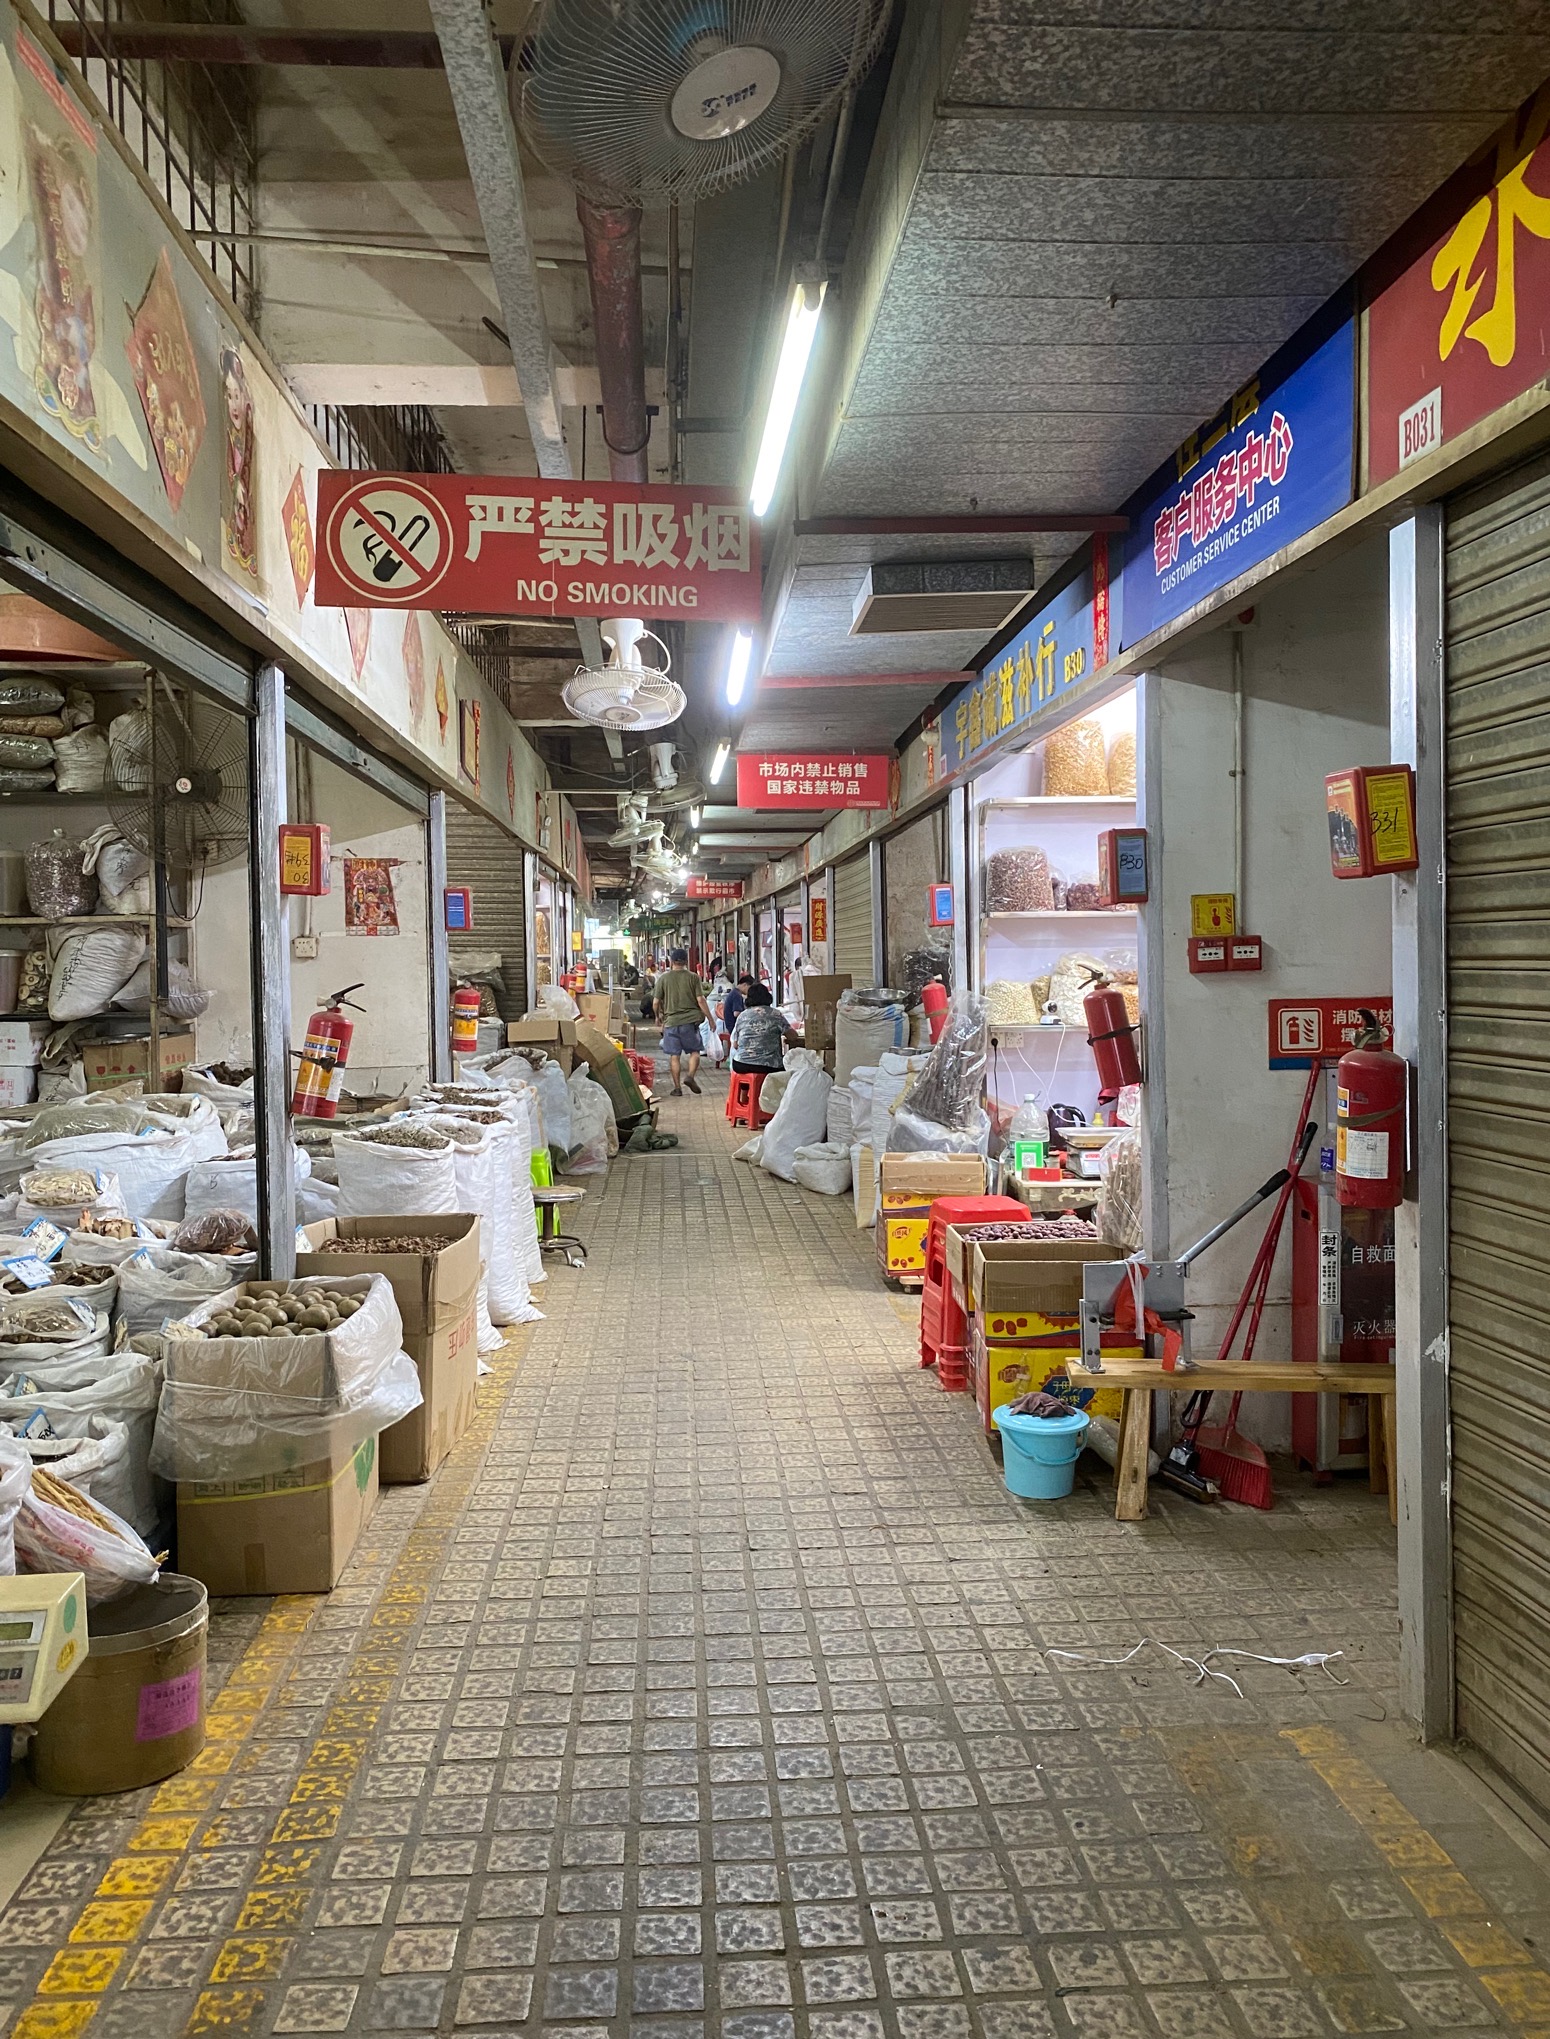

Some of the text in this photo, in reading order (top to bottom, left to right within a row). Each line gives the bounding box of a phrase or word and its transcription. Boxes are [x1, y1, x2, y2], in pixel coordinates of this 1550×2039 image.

[1403, 402, 1436, 460] B031
[1153, 410, 1294, 577] 客户服务中心
[464, 494, 751, 573] 严禁吸烟
[1161, 495, 1280, 594] CUSTOMER SERVICE CENTER
[516, 579, 698, 607] NO SMOKING
[1063, 647, 1087, 684] B30
[758, 762, 868, 778] 市场内禁止销售
[767, 780, 861, 795] 国家违禁物品
[1119, 853, 1144, 870] B30
[1321, 1234, 1337, 1257] 封条
[1351, 1244, 1396, 1264] 自救面
[1352, 1319, 1396, 1336] 灭火器
